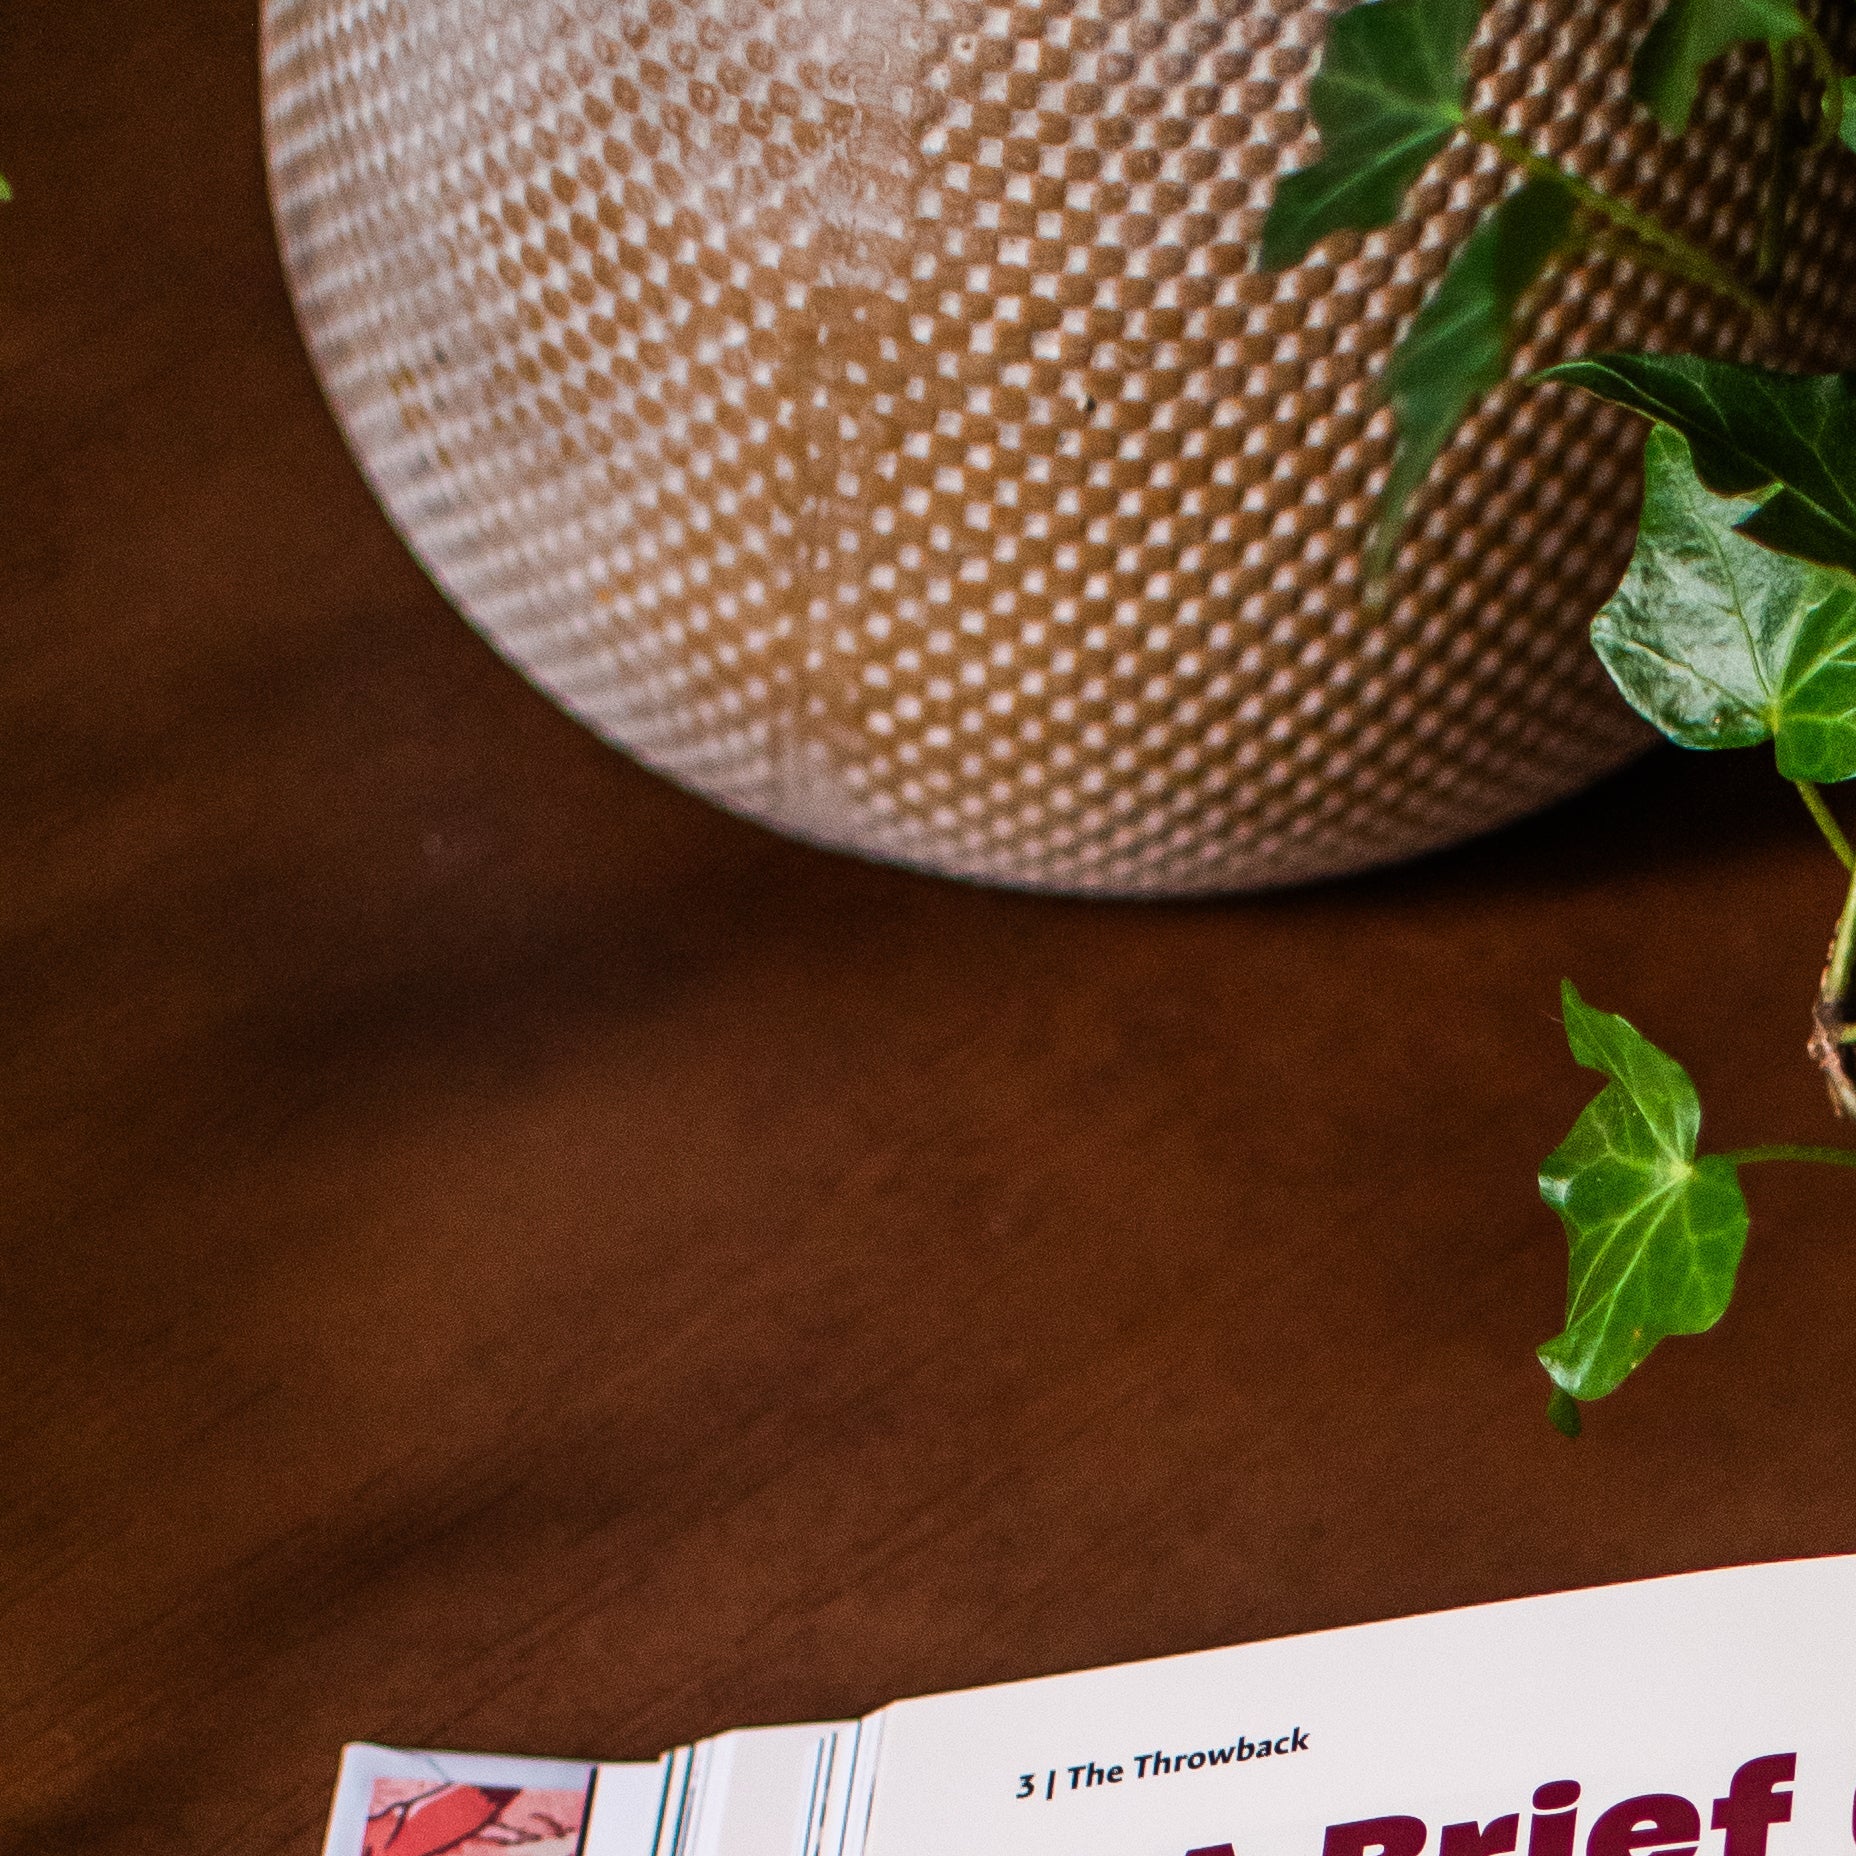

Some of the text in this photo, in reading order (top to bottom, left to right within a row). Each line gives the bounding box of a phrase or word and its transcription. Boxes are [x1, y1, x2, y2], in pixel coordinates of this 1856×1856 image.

[1017, 1727, 1308, 1799] 3 The Throwback
